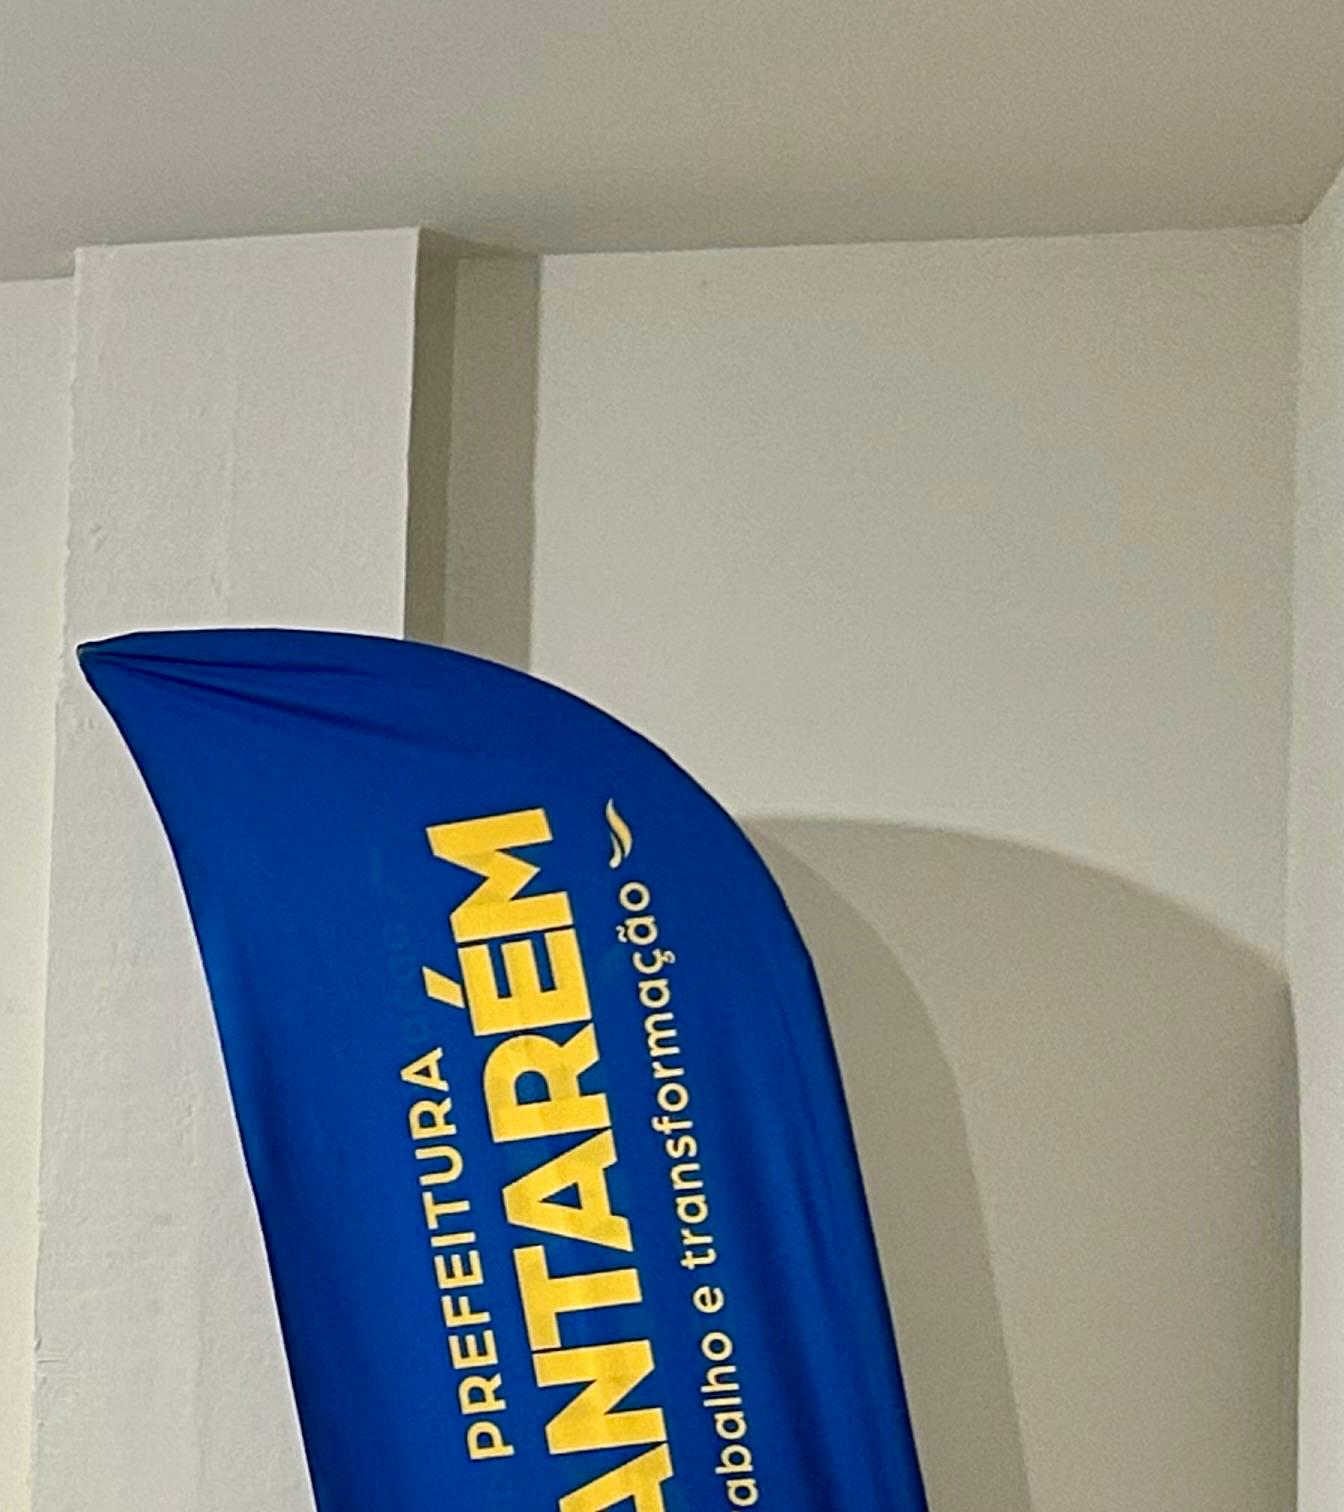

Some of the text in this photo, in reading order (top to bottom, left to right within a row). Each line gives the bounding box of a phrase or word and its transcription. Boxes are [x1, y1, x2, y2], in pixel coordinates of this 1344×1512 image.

[400, 1047, 514, 1461] PREFEITURA
[617, 881, 717, 1270] transformação
[692, 1285, 725, 1314] e
